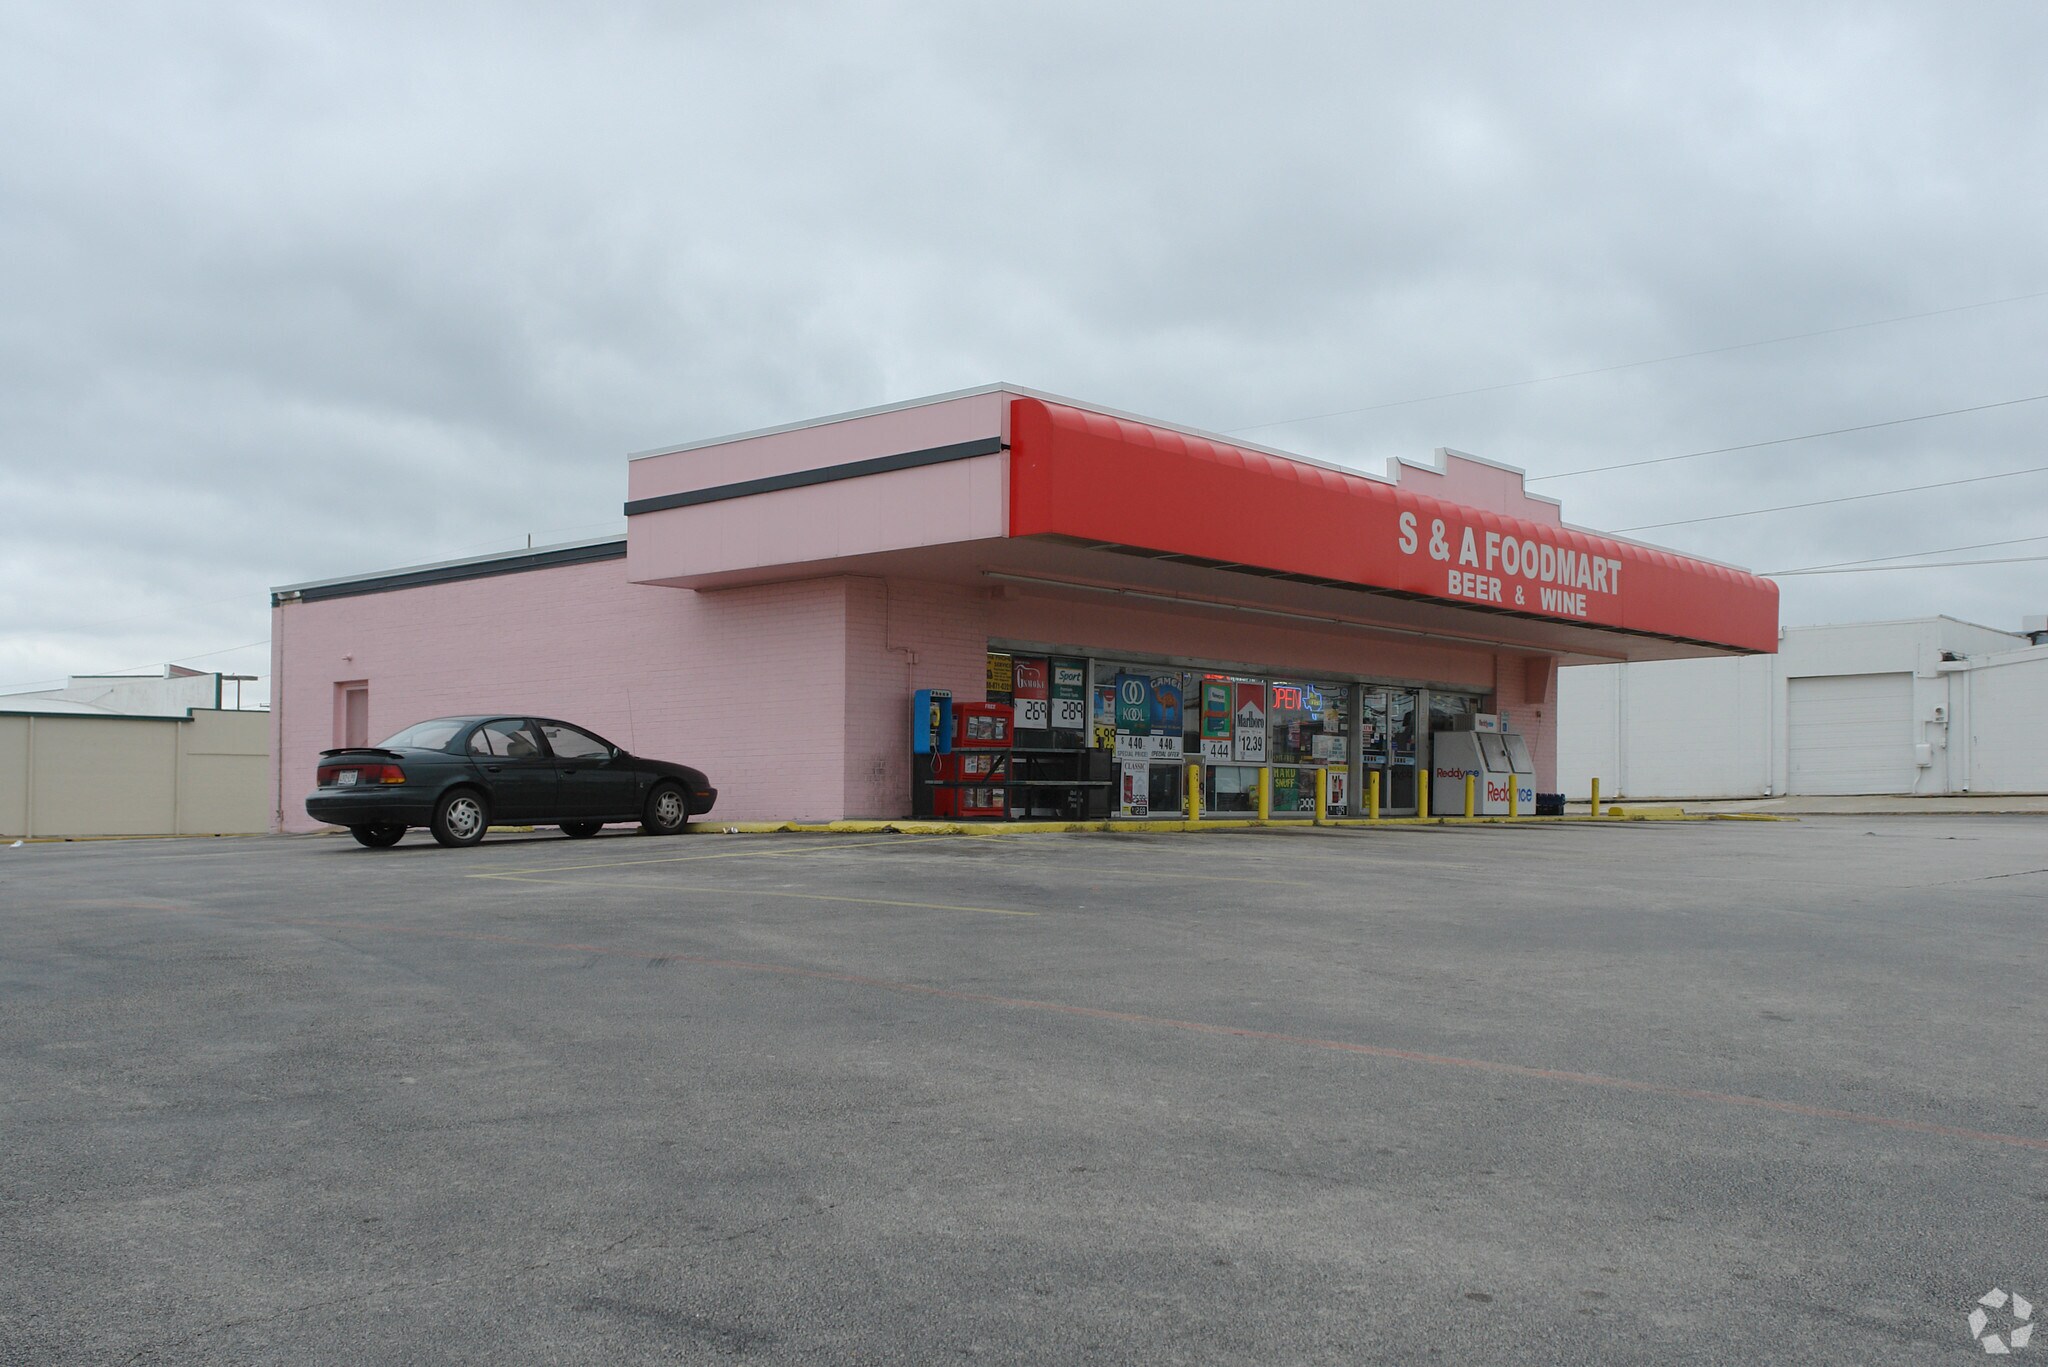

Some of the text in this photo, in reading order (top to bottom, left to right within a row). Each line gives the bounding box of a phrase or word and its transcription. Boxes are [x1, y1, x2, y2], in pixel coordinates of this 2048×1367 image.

[1399, 512, 1622, 595] S & A FOODMART
[1448, 570, 1587, 617] BEER & WINE
[1059, 670, 1081, 682] Sport
[1151, 678, 1183, 690] CAMEL
[1123, 708, 1144, 721] KOOL
[1238, 711, 1264, 728] Marlboro
[1124, 762, 1146, 770] CLASSIC
[1275, 779, 1294, 788] SNUFF
